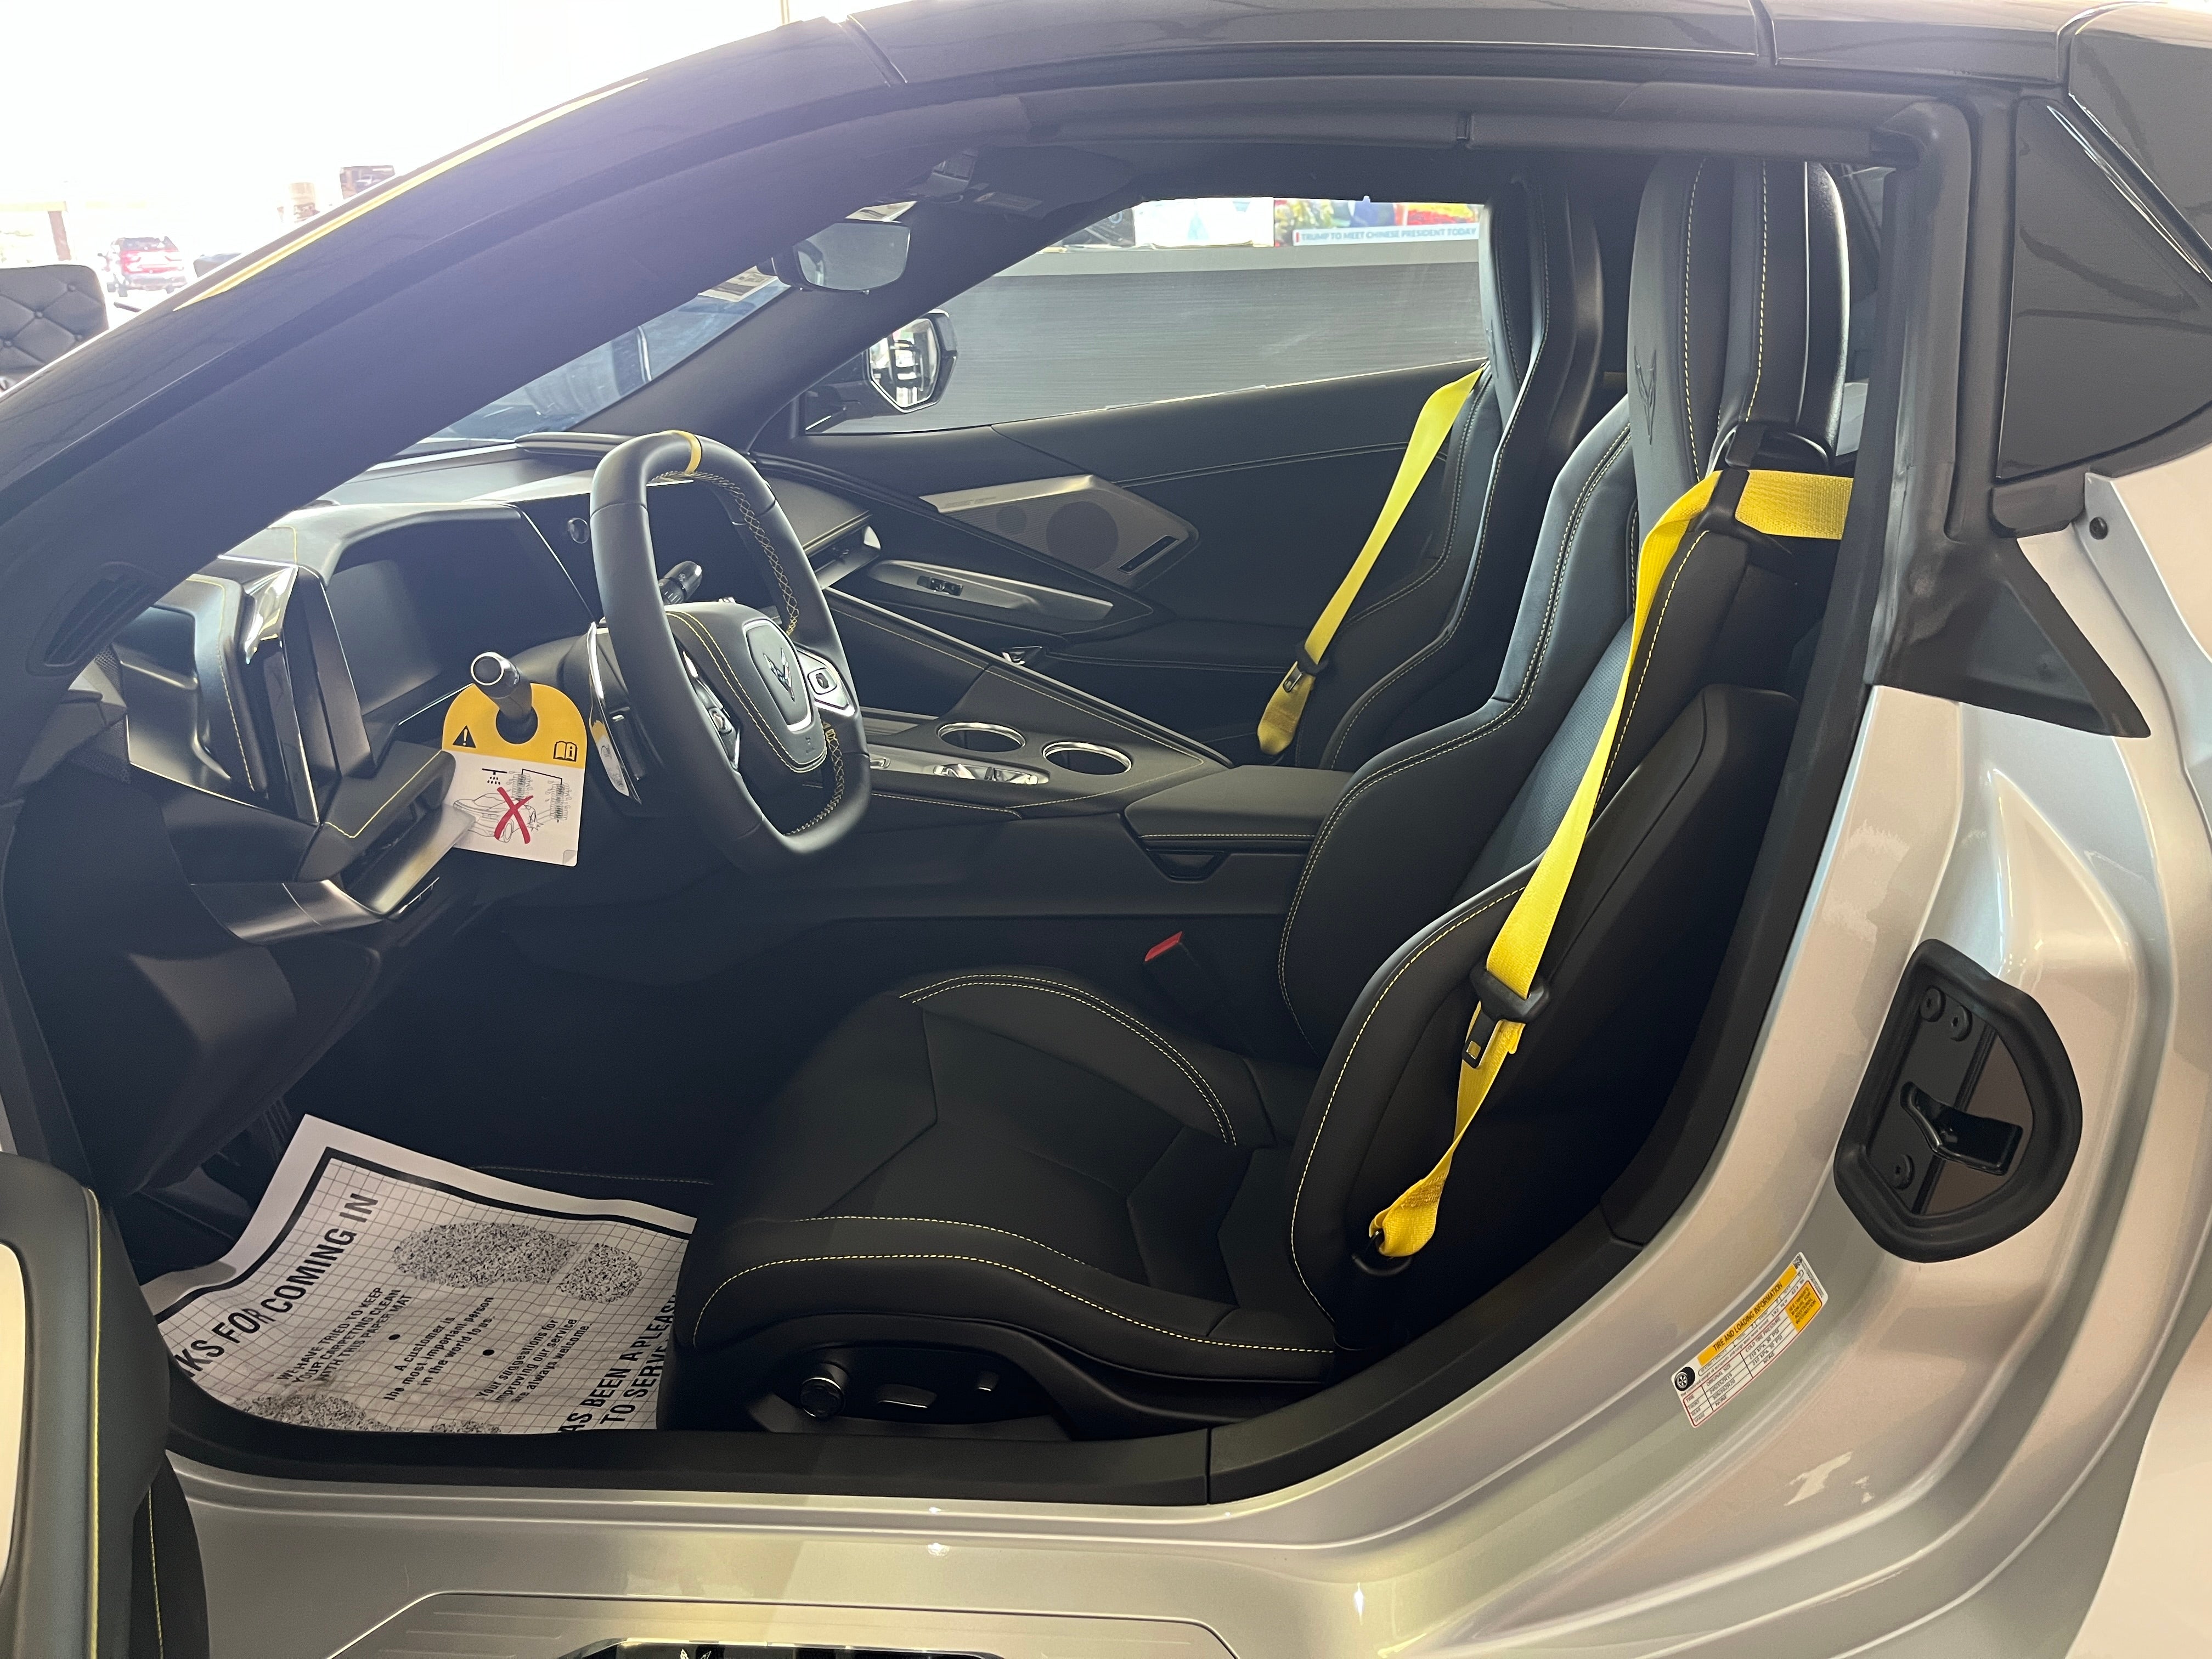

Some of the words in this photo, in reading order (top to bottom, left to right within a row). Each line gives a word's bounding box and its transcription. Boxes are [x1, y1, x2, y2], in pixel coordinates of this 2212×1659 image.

[1301, 233, 1329, 241] TRUMP
[1331, 232, 1341, 240] TO
[1344, 231, 1365, 240] MEET
[1366, 230, 1399, 239] CHINESE
[1401, 228, 1446, 238] PRESIDENT
[1447, 227, 1477, 236] TODAY
[175, 1340, 225, 1378] KS
[212, 1308, 276, 1344] FOR
[261, 1228, 357, 1313] COMING
[339, 1193, 379, 1223] IN
[1712, 1339, 1725, 1351] TIRE
[1724, 1330, 1735, 1342] AND
[1734, 1311, 1754, 1333] LOADING
[1754, 1282, 1782, 1315] INFORMATION
[276, 1369, 298, 1380] WE
[297, 1346, 324, 1369] HAVE
[318, 1323, 350, 1344] TRIED
[346, 1310, 363, 1321] TO
[359, 1288, 383, 1308] KEEP
[291, 1362, 323, 1383] YOUR
[320, 1317, 374, 1359] CARPETING
[370, 1289, 401, 1316] CLEAN
[313, 1359, 343, 1382] WITH
[338, 1340, 366, 1357] THIS
[360, 1312, 394, 1338] PAPER
[390, 1295, 412, 1313] MAT
[384, 1387, 405, 1400] the
[402, 1362, 427, 1385] most
[421, 1323, 467, 1359] important
[464, 1297, 494, 1322] person
[404, 1324, 445, 1362] customer
[418, 1376, 433, 1386] in
[428, 1359, 448, 1374] the
[444, 1335, 472, 1358] world
[475, 1381, 501, 1397] Your
[499, 1331, 548, 1380] suggestions
[541, 1319, 558, 1331] for
[527, 1361, 558, 1390] always
[552, 1323, 592, 1359] welcome.
[533, 1348, 550, 1362] our
[546, 1319, 577, 1347] service
[1745, 1341, 1756, 1352] COLD
[579, 1368, 632, 1407] BEEN
[619, 1351, 644, 1361] A
[599, 1404, 636, 1424] TO
